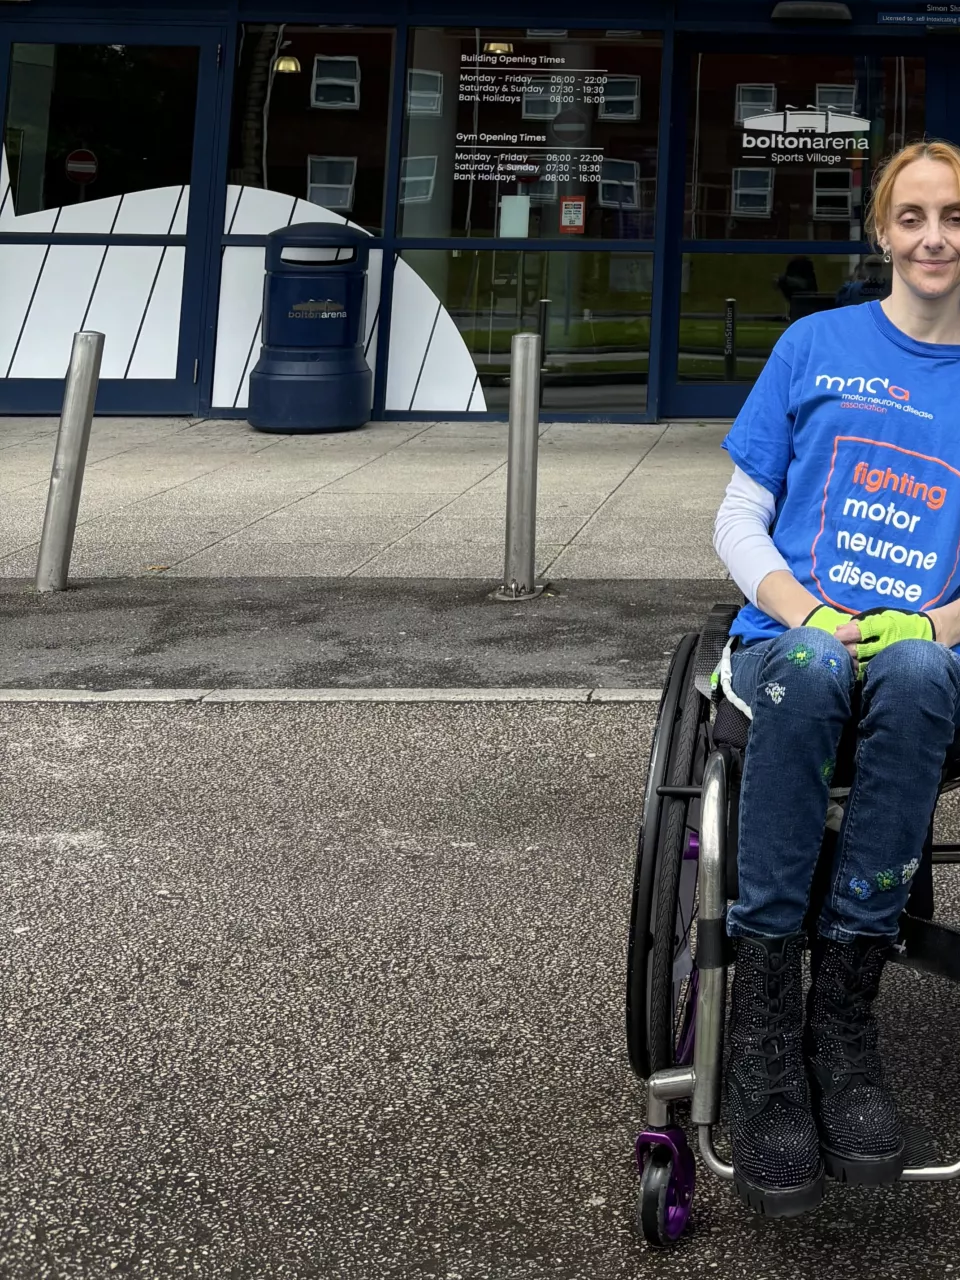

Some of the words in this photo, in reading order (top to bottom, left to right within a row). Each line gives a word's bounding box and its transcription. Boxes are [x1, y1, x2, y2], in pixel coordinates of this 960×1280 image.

[926, 4, 948, 12] Simon
[926, 16, 957, 24] intoxicating
[461, 54, 497, 65] Building
[499, 55, 537, 65] Opening
[539, 55, 566, 64] Times
[459, 74, 496, 83] Monday
[505, 74, 533, 84] Friday
[551, 75, 576, 84] 06:00
[584, 76, 608, 84] 22:00
[459, 84, 500, 93] Saturday
[501, 84, 509, 92] &
[510, 84, 544, 94] Sunday
[550, 85, 574, 94] 07:30
[582, 86, 605, 94] 19:30
[458, 94, 481, 102] Bank
[482, 94, 521, 103] Holidays
[549, 95, 574, 103] 08:00
[583, 96, 605, 104] 16:00
[455, 132, 478, 142] Gym
[479, 133, 518, 142] Opening
[519, 133, 547, 142] Times
[742, 133, 870, 150] boltonarena
[455, 153, 491, 162] Monday
[500, 153, 528, 163] Friday
[546, 154, 571, 162] 06:00
[771, 153, 804, 164] Sports
[806, 153, 842, 164] Village
[454, 163, 496, 172] Saturday
[497, 163, 504, 171] &
[506, 164, 540, 173] Sunday
[545, 164, 570, 172] 07:30
[453, 173, 476, 181] Bank
[477, 173, 516, 182] Holidays
[545, 174, 570, 182] 08:00
[840, 400, 888, 414] association
[842, 392, 867, 402] motor
[867, 396, 902, 410] neurone
[902, 404, 934, 420] disease
[853, 461, 947, 510] fighting
[842, 497, 921, 533] motor
[836, 527, 938, 570] neurone
[828, 560, 923, 602] disease
